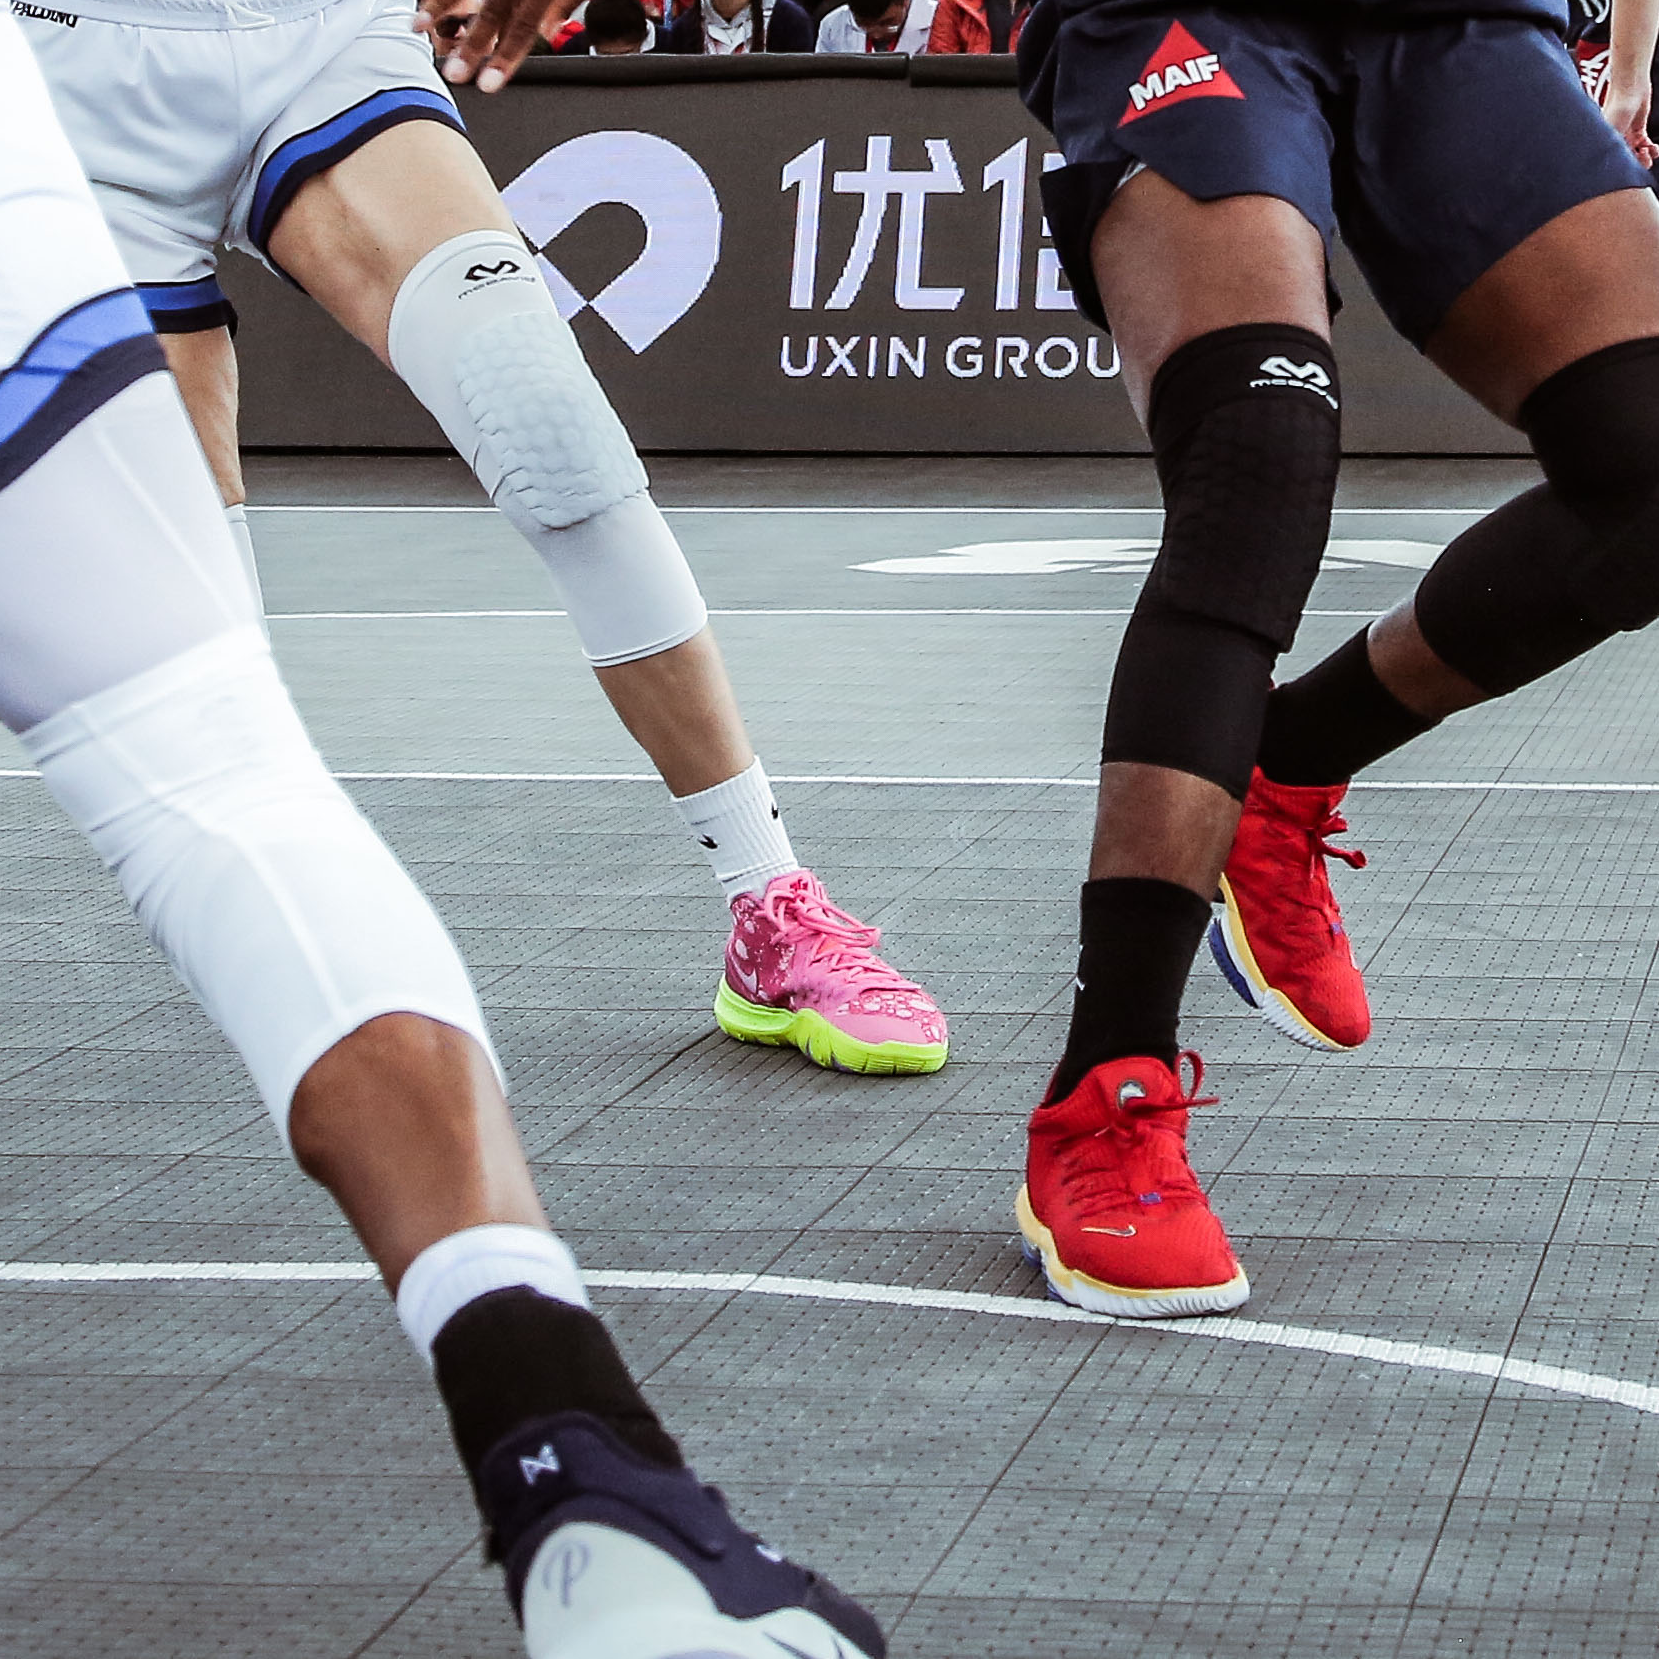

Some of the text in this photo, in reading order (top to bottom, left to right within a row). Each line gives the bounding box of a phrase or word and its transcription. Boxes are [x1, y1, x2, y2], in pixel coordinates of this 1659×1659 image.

[1129, 54, 1220, 110] MAIF
[780, 336, 1121, 379] UXIN GROU
